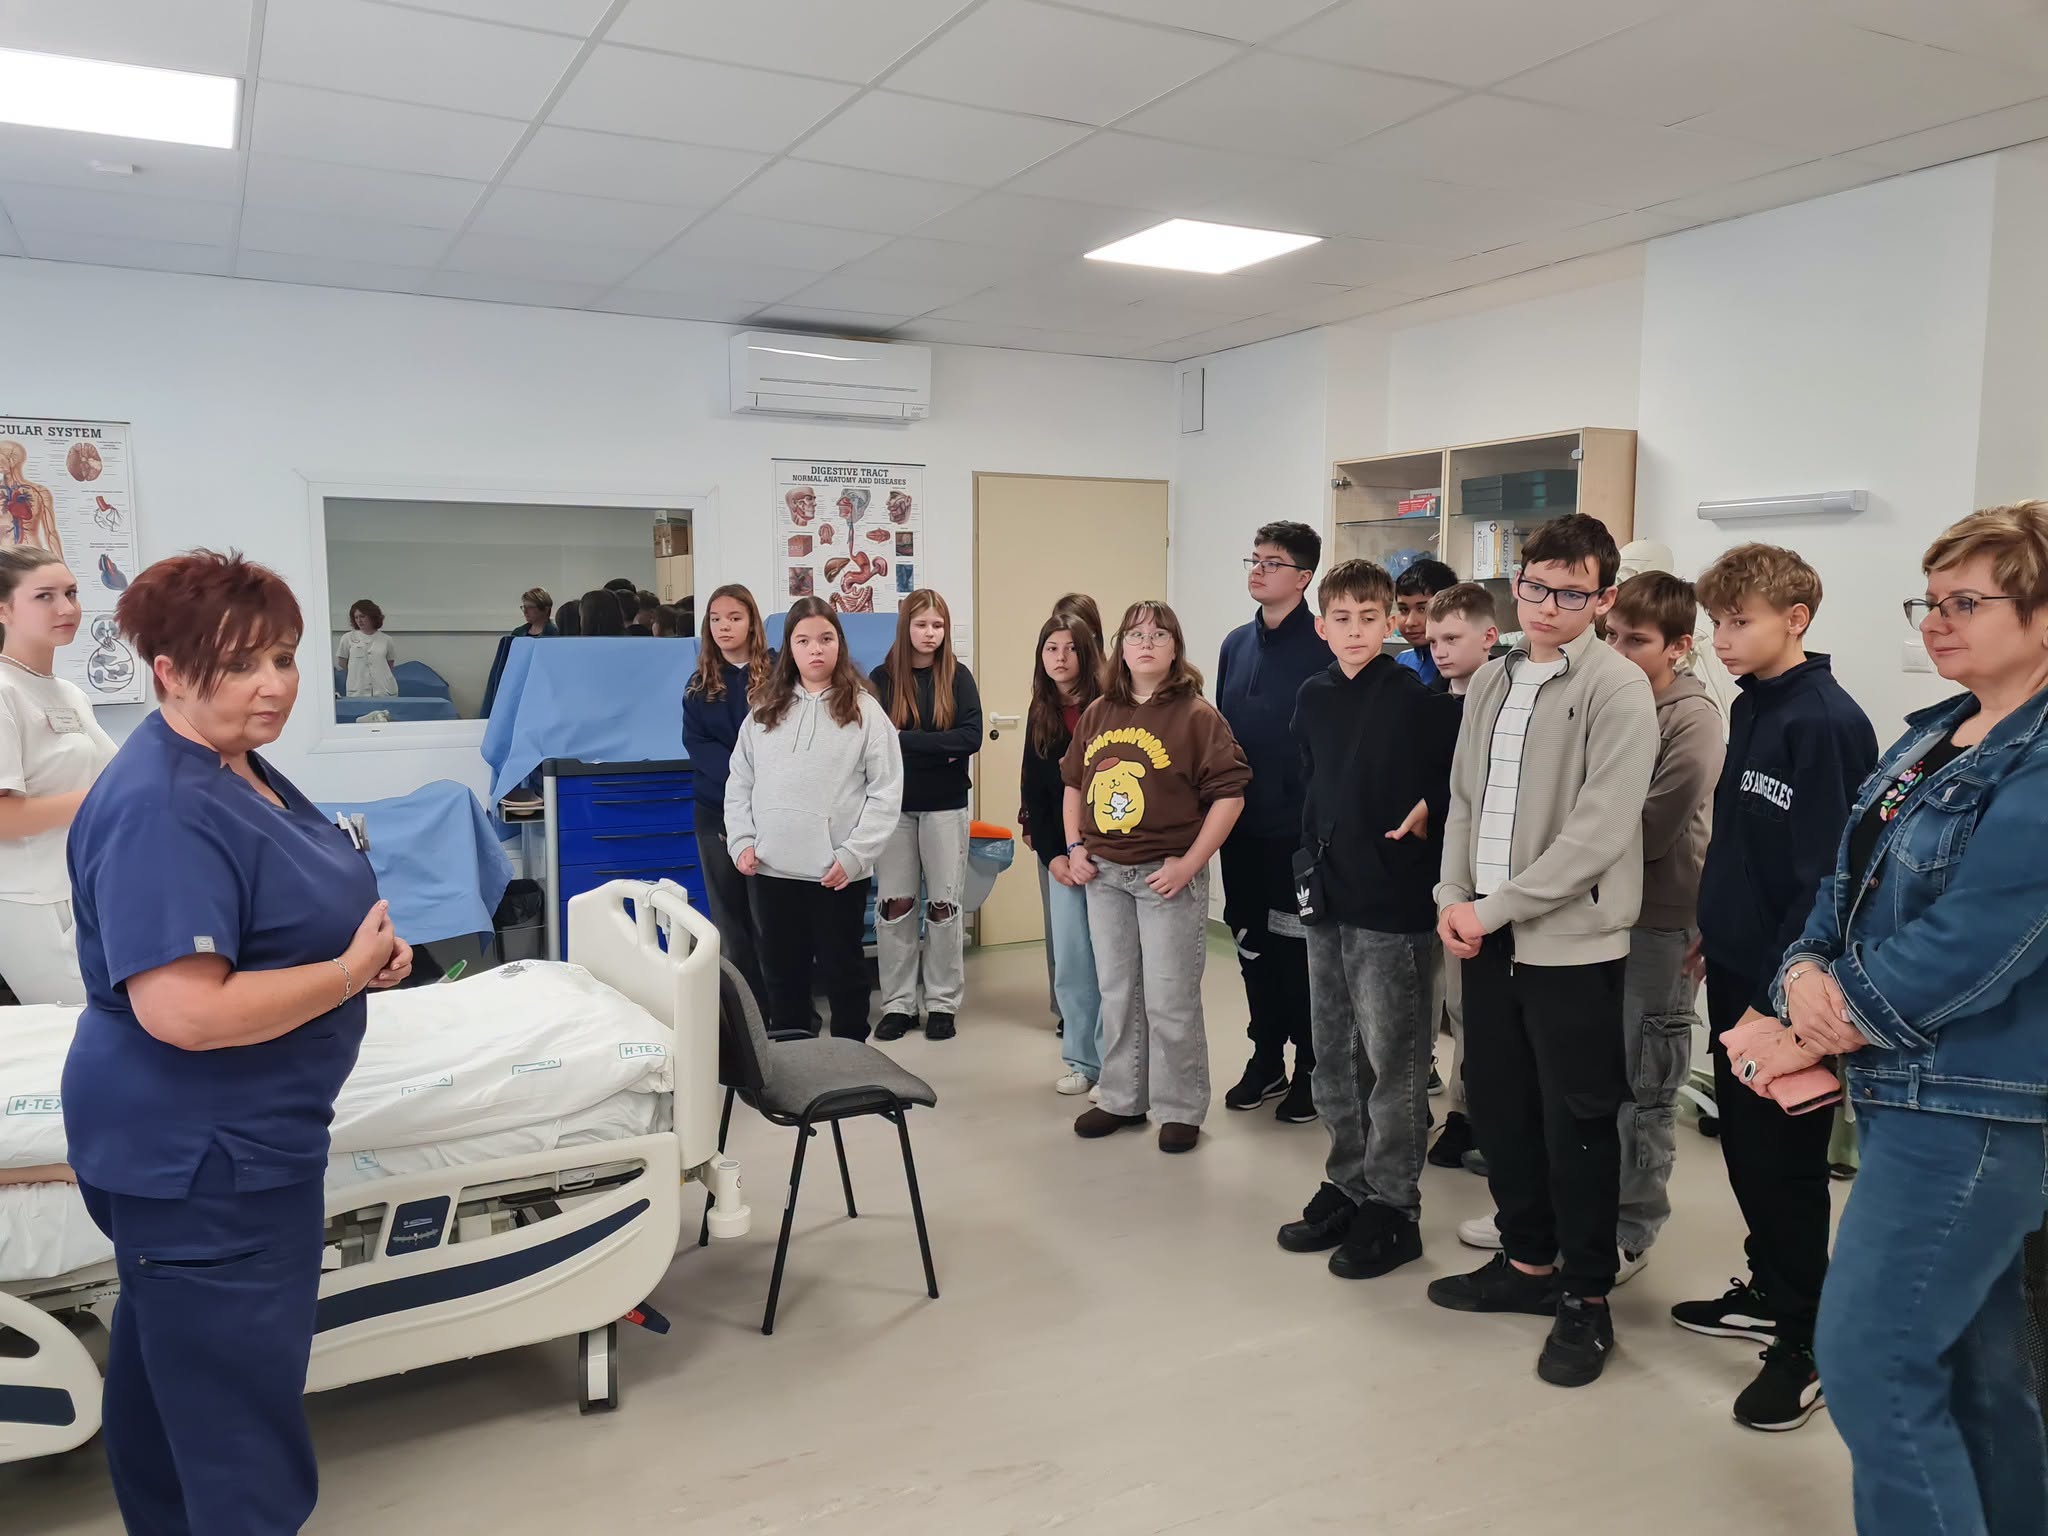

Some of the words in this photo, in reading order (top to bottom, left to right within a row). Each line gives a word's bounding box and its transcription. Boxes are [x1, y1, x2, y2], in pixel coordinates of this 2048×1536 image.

[0, 424, 43, 436] CULAR
[48, 426, 102, 438] SYSTEM
[811, 466, 858, 476] DIGESTIVE
[861, 468, 888, 477] TRACT
[792, 474, 822, 483] NORMAL
[823, 475, 856, 484] ANATOMY
[859, 476, 873, 484] AND
[874, 478, 907, 486] DISEASES
[1083, 726, 1172, 770] POMPOMPURIN
[624, 1045, 662, 1056] H-TEX
